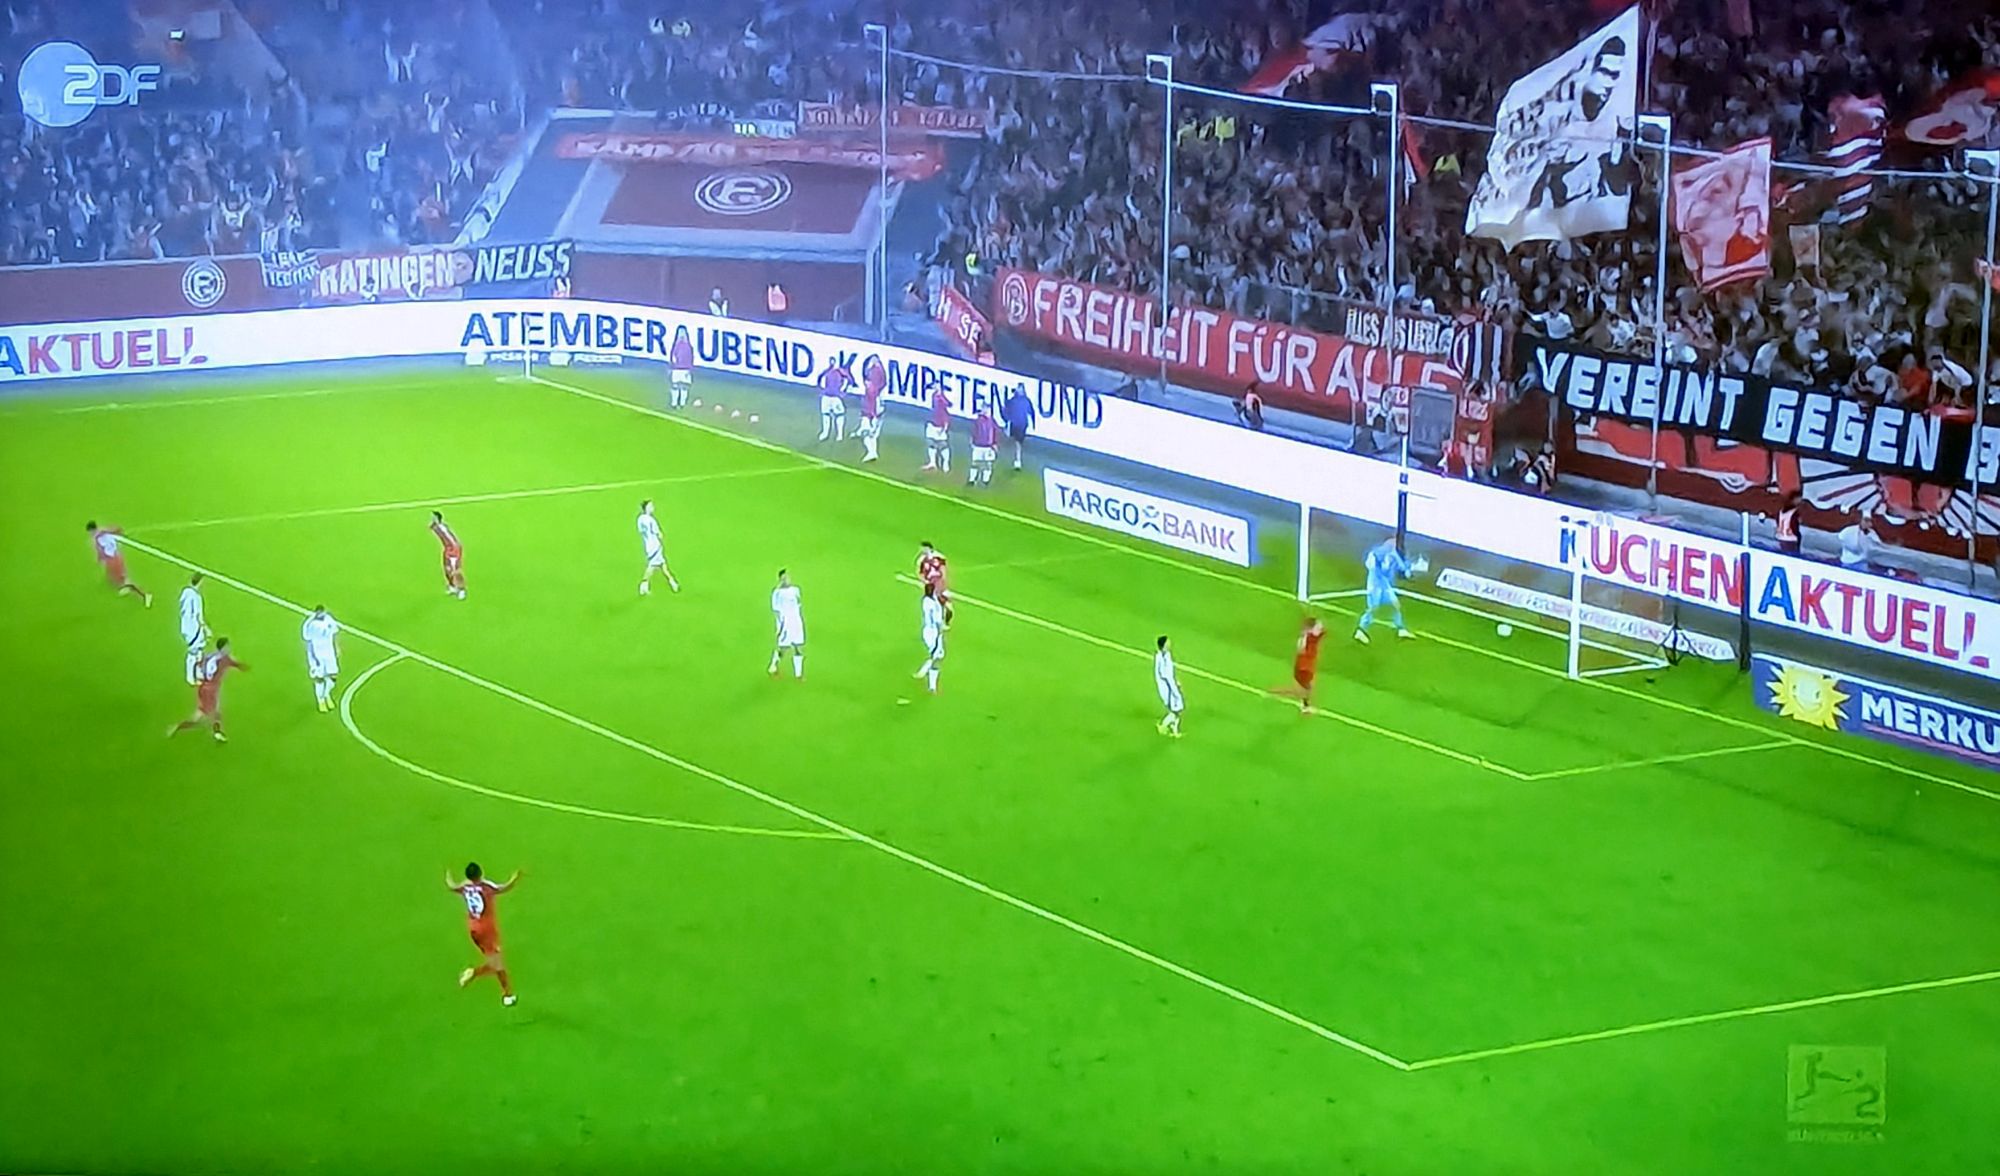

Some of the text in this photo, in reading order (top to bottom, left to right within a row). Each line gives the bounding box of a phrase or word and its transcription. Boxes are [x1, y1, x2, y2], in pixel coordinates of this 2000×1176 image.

[473, 242, 573, 284] NEUSS
[1033, 278, 1220, 368] FREIHEIT
[1227, 319, 1316, 394] FÜR
[1038, 379, 1103, 429] UND
[1535, 346, 1745, 431] VEREINT
[1761, 386, 1942, 472] GEGEN
[1861, 691, 2000, 754] MERKU
